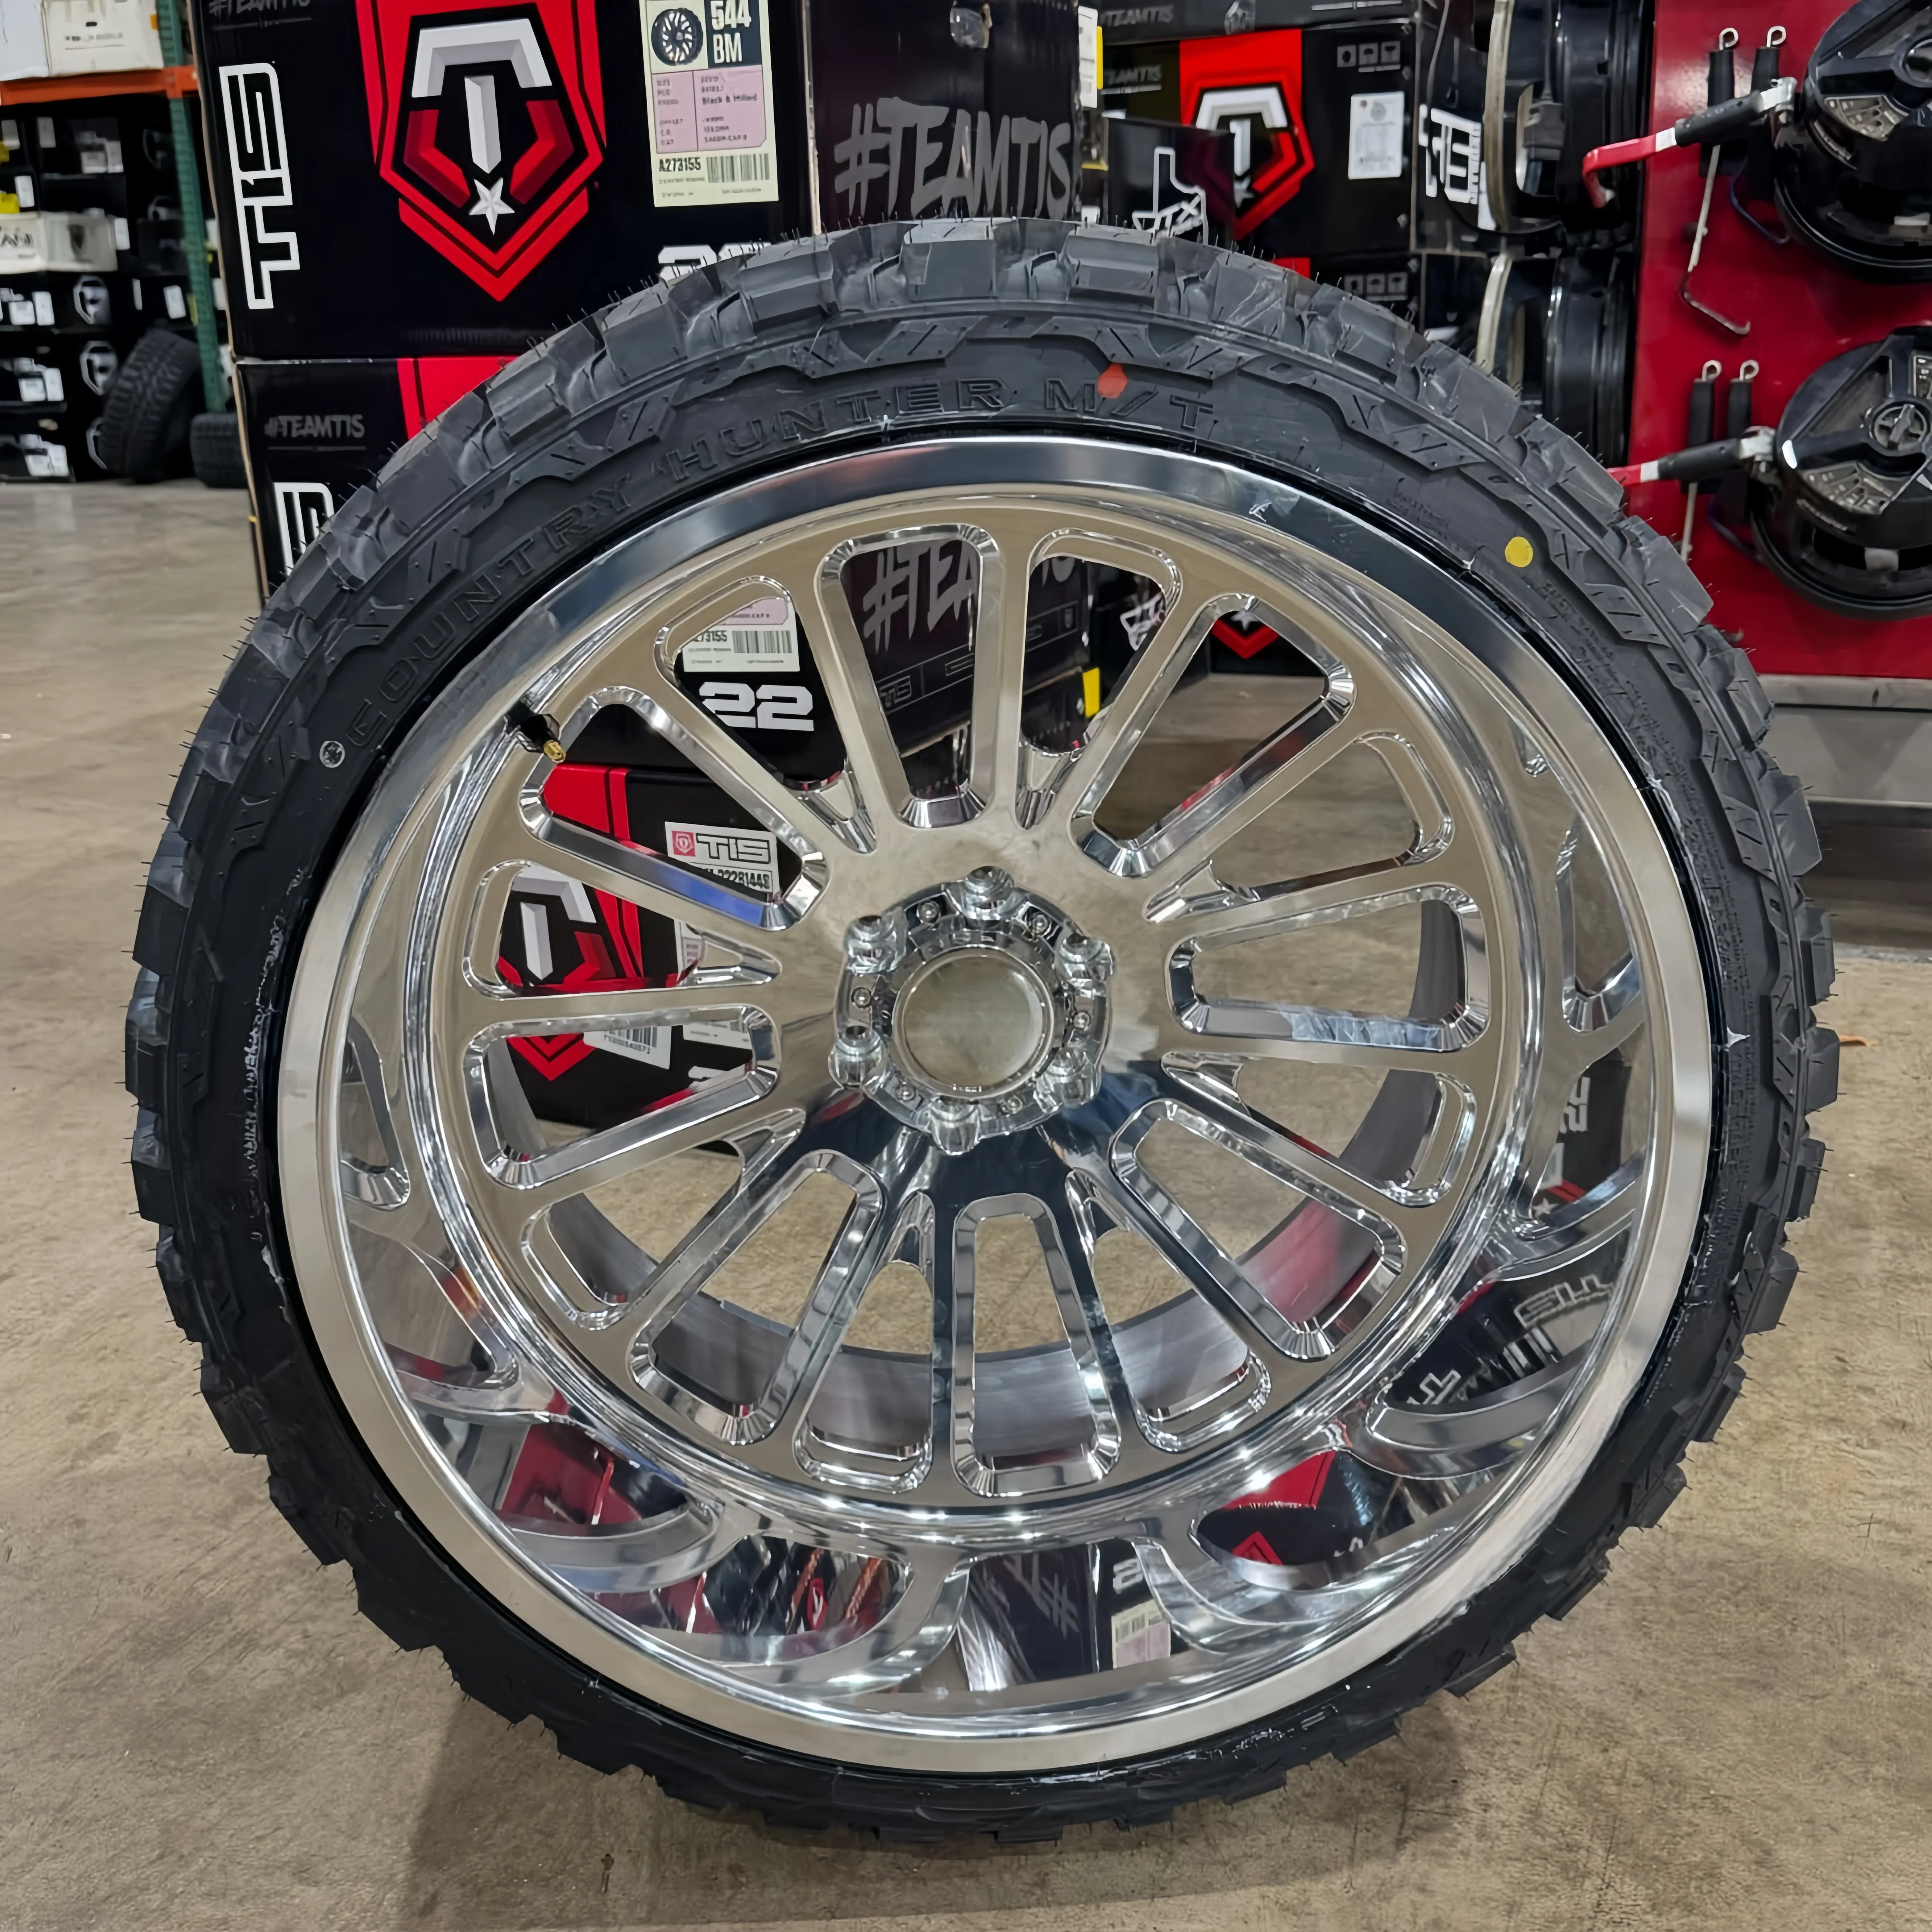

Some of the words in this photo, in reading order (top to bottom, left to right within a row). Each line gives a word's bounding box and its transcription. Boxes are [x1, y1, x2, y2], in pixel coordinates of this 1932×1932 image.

[710, 0, 752, 30] 544
[713, 32, 742, 63] BM
[659, 157, 701, 172] A273155
[834, 97, 1071, 220] #TEAMTIS
[345, 472, 632, 747] COUNTRY
[664, 377, 1007, 484] HUNTER
[1044, 378, 1214, 431] M/T
[694, 629, 728, 642] 73155
[699, 681, 814, 731] 22
[695, 832, 771, 865] TIS
